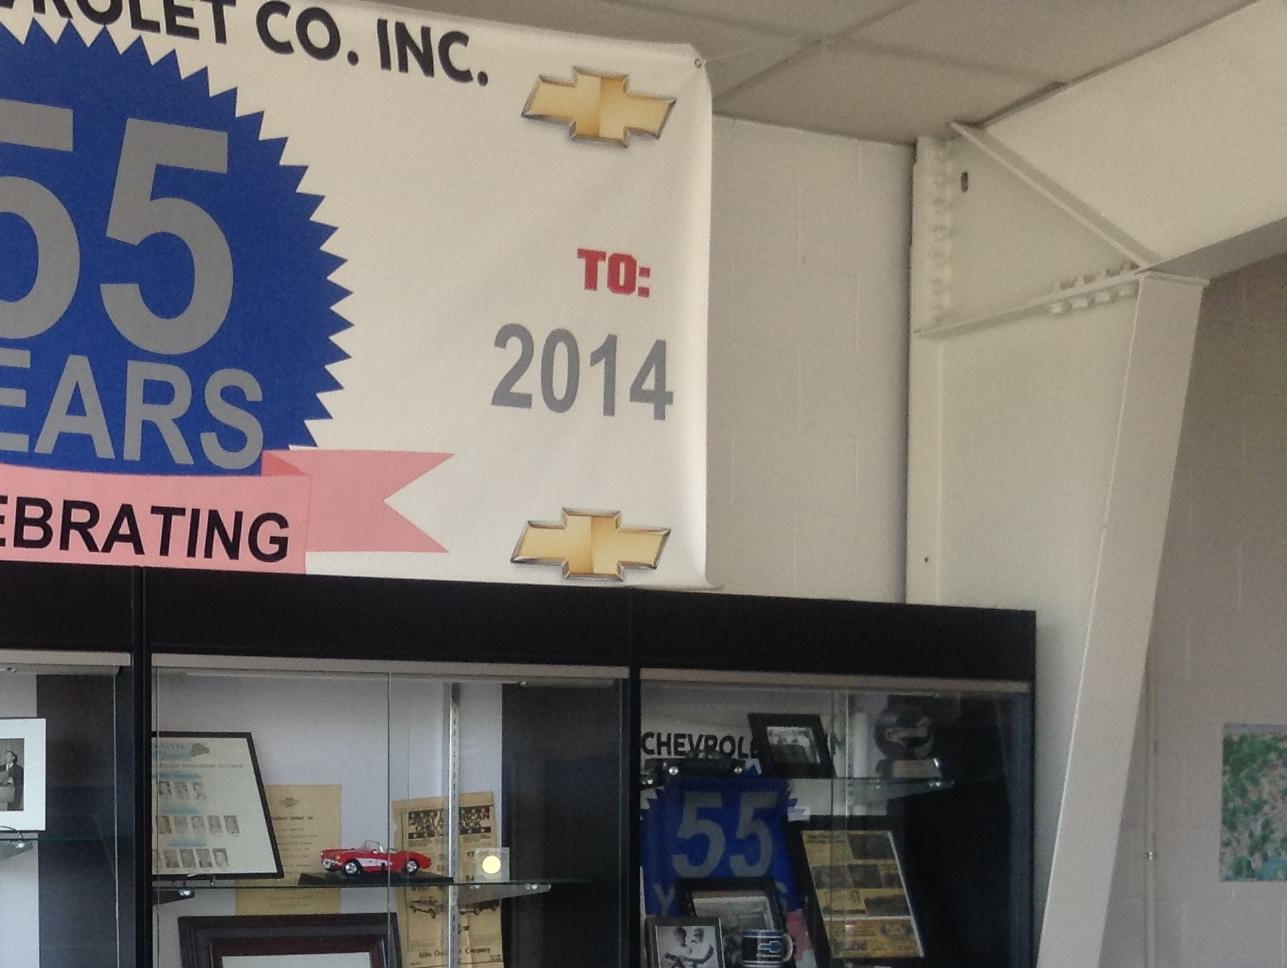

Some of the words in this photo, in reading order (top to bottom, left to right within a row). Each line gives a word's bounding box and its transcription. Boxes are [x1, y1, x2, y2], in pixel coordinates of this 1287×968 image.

[256, 0, 359, 66] CO.
[378, 19, 489, 87] INC.
[577, 249, 652, 299] TO:
[492, 323, 675, 421] 2014
[641, 732, 758, 759] CHEVROL
[672, 791, 780, 878] 55
